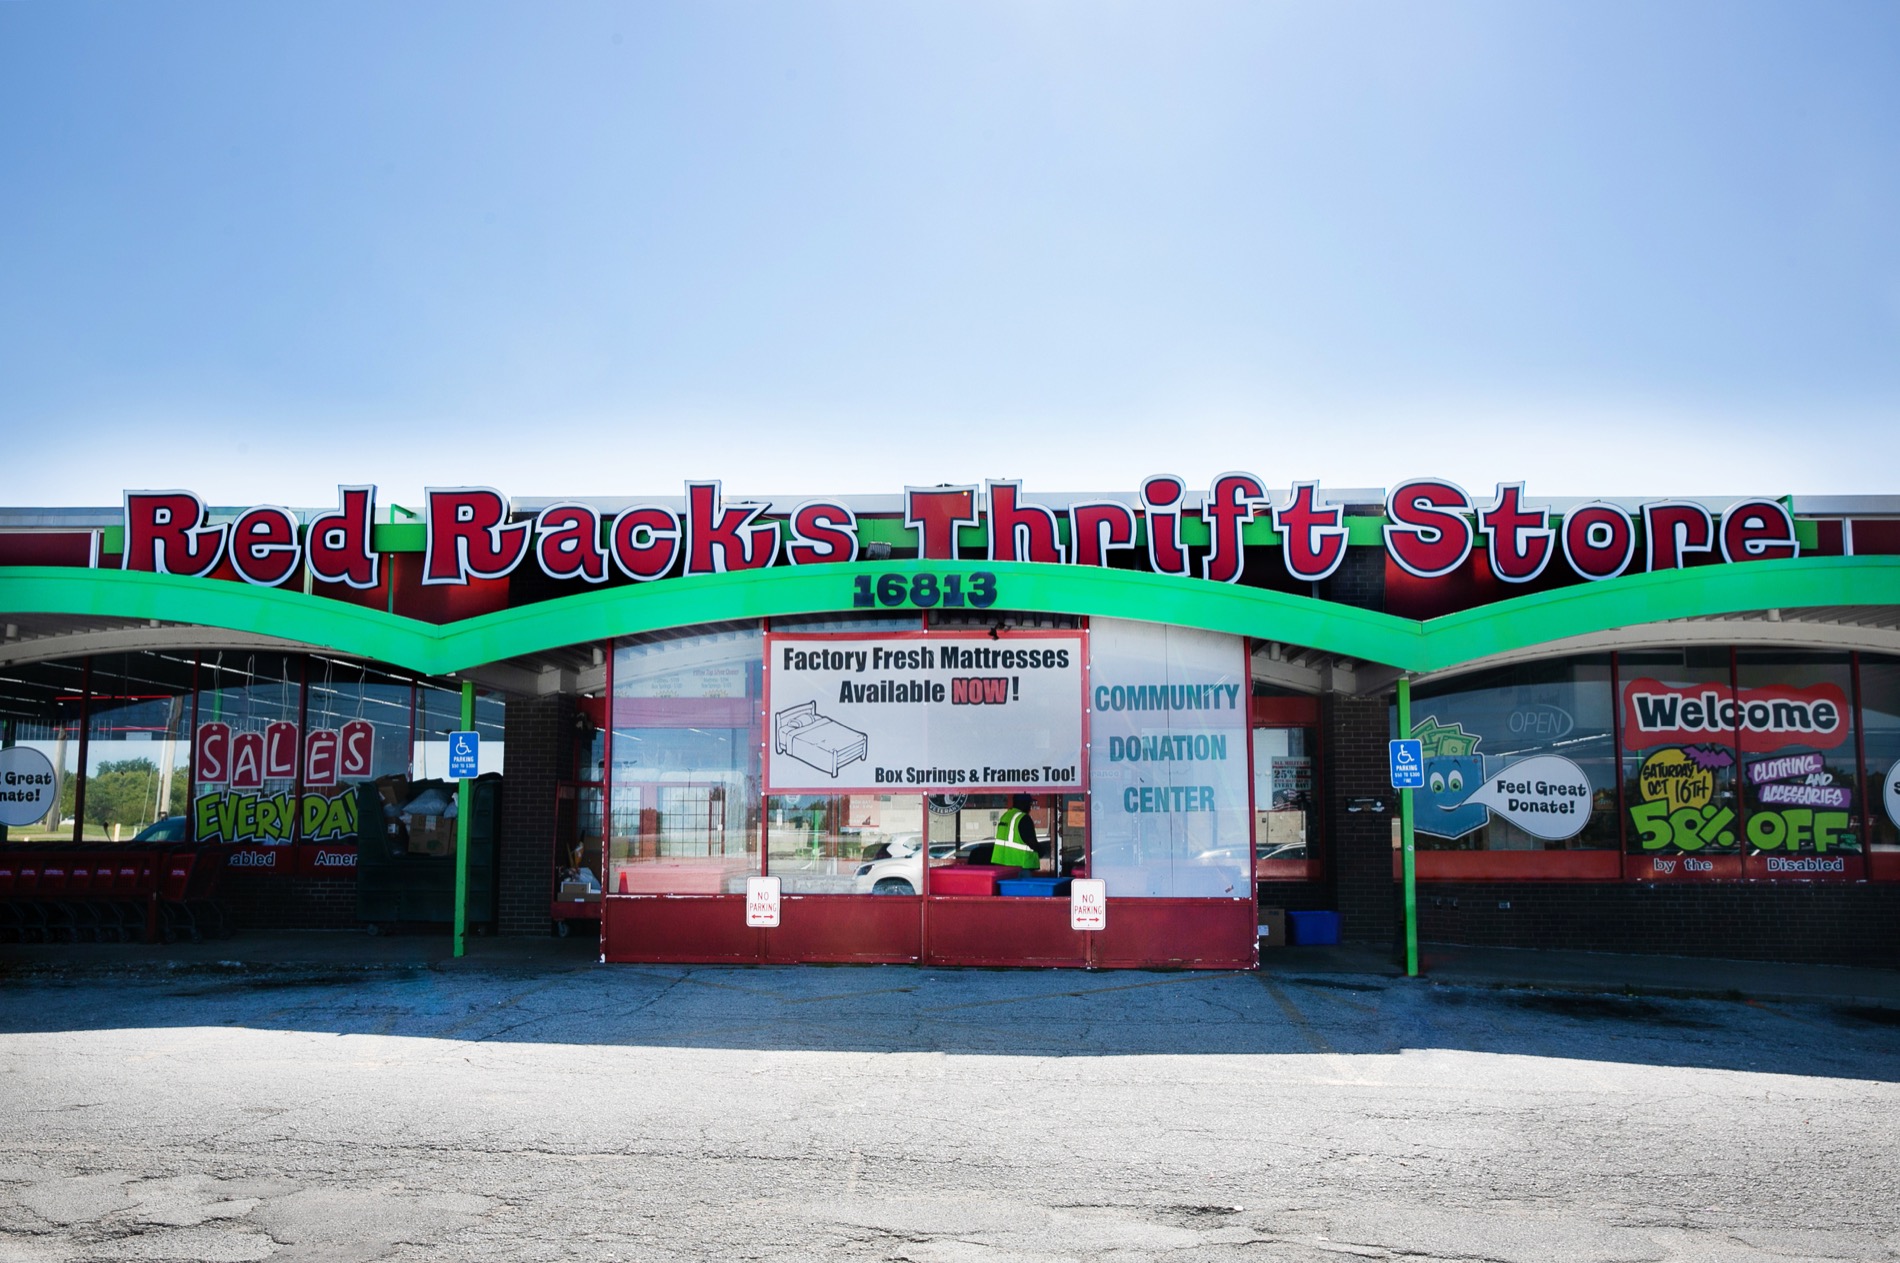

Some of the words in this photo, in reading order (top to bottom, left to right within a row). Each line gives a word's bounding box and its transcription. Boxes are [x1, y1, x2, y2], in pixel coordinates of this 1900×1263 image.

[122, 484, 378, 588] Red
[422, 478, 858, 587] Racks
[904, 471, 1350, 581] Thrift
[1384, 476, 1800, 583] Store
[853, 572, 998, 608] 16813
[783, 648, 867, 672] Factory
[873, 646, 934, 669] Fresh
[940, 646, 1069, 669] Mattresses
[839, 680, 945, 703] Available
[1095, 684, 1240, 711] COMMUNITY
[1632, 691, 1840, 733] Welcome
[1508, 711, 1563, 734] OPEN
[202, 731, 365, 782] SALES
[1109, 734, 1226, 762] DONATION
[5, 771, 52, 786] Great
[875, 767, 903, 783] Box
[906, 767, 966, 784] Springs
[969, 767, 980, 782] &
[983, 766, 1039, 782] Frames
[1043, 766, 1076, 782] Too!
[1274, 770, 1297, 778] 25%
[1753, 755, 1821, 782] CLOTHING
[1496, 780, 1531, 795] Feel
[1535, 781, 1587, 797] Great
[1805, 773, 1833, 786] AND
[0, 789, 41, 802] nate!
[1123, 785, 1215, 813] CENTER
[1648, 778, 1669, 796] OCT
[1675, 779, 1710, 803] 16TH
[1762, 785, 1843, 805] ACCESSORIES
[930, 804, 960, 814] VETERANS
[1508, 798, 1575, 814] Donate!
[194, 790, 296, 844] EVERY
[1629, 799, 1736, 851] 50%
[1746, 809, 1849, 852] OFF
[229, 851, 275, 866] abled
[314, 851, 358, 866] Amer
[1653, 858, 1676, 873] by
[1684, 858, 1713, 872] the
[1767, 858, 1844, 872] Disabled
[757, 892, 769, 901] NO
[1082, 894, 1094, 903] NO
[750, 902, 776, 912] PARKING
[1074, 906, 1102, 915] PARKING
